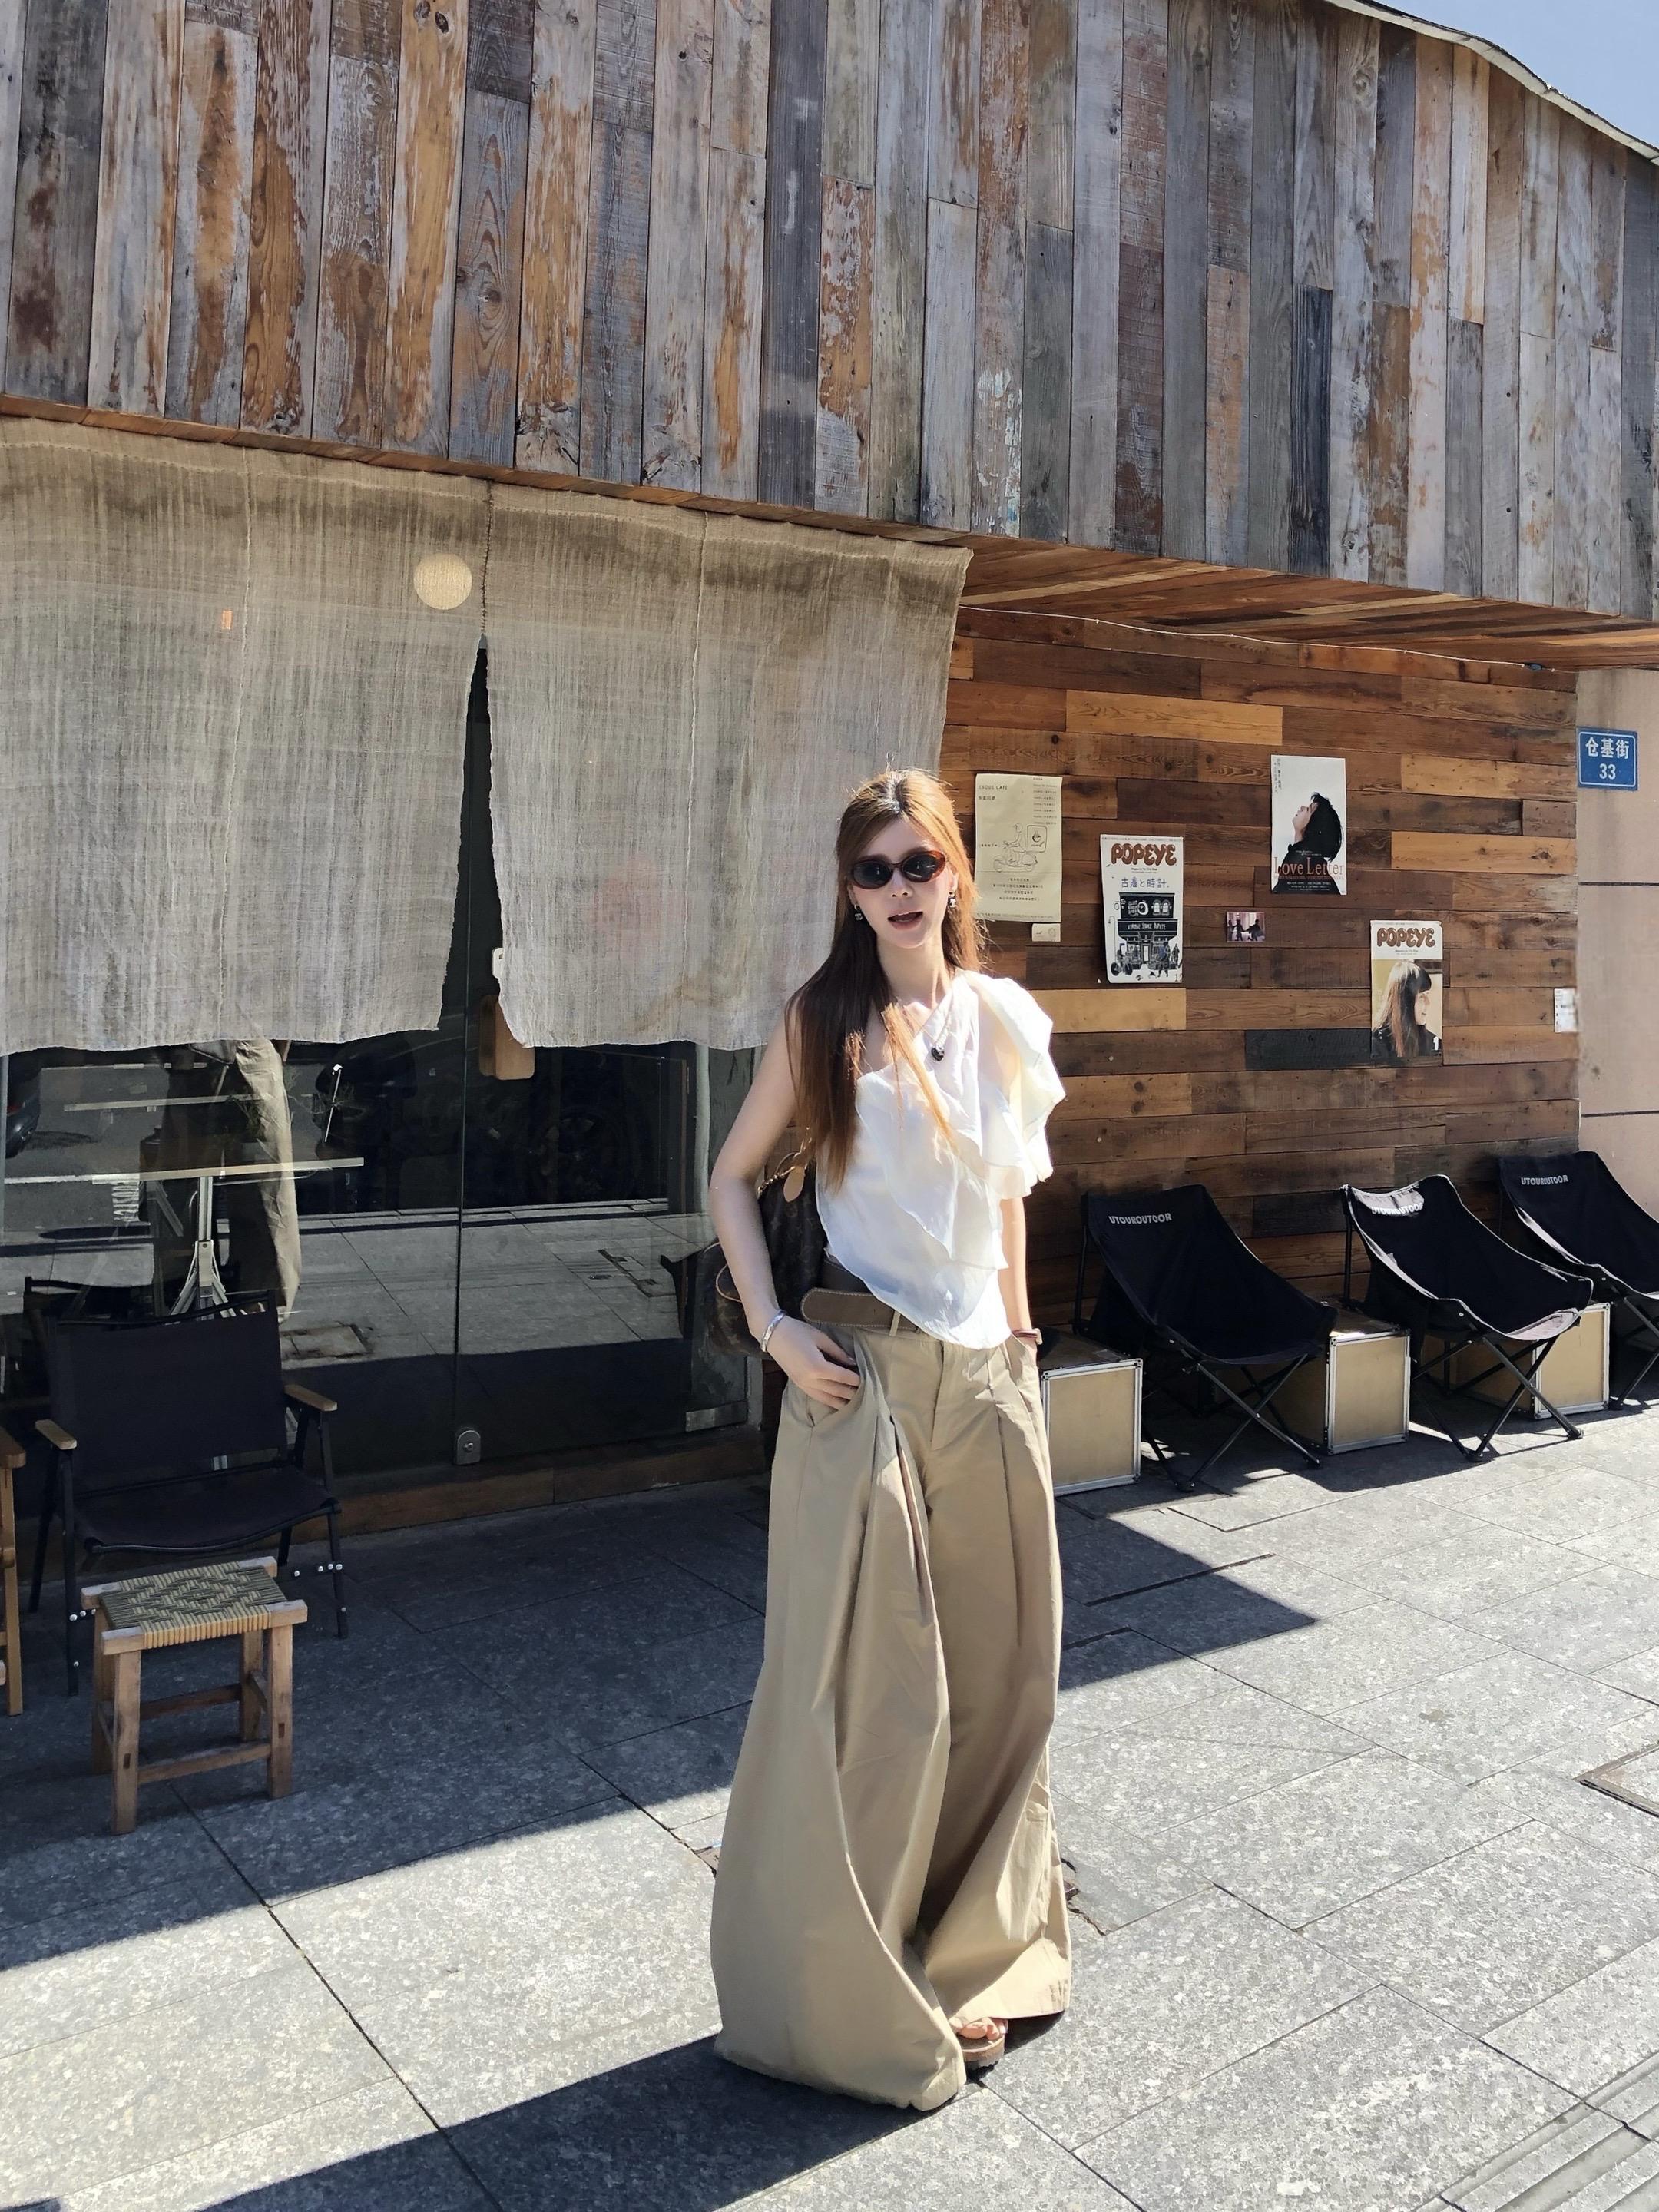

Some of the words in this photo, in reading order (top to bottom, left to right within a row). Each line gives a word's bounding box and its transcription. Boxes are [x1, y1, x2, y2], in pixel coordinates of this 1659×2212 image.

[1585, 737, 1629, 759] 仓基街
[1599, 763, 1616, 780] 33
[1111, 843, 1177, 866] POPEYE
[1273, 856, 1304, 875] Love
[1306, 856, 1344, 875] Letter
[1377, 927, 1436, 948] POPEYE
[1433, 1036, 1439, 1051] 1
[1108, 1212, 1173, 1224] UTOUROUTOOR
